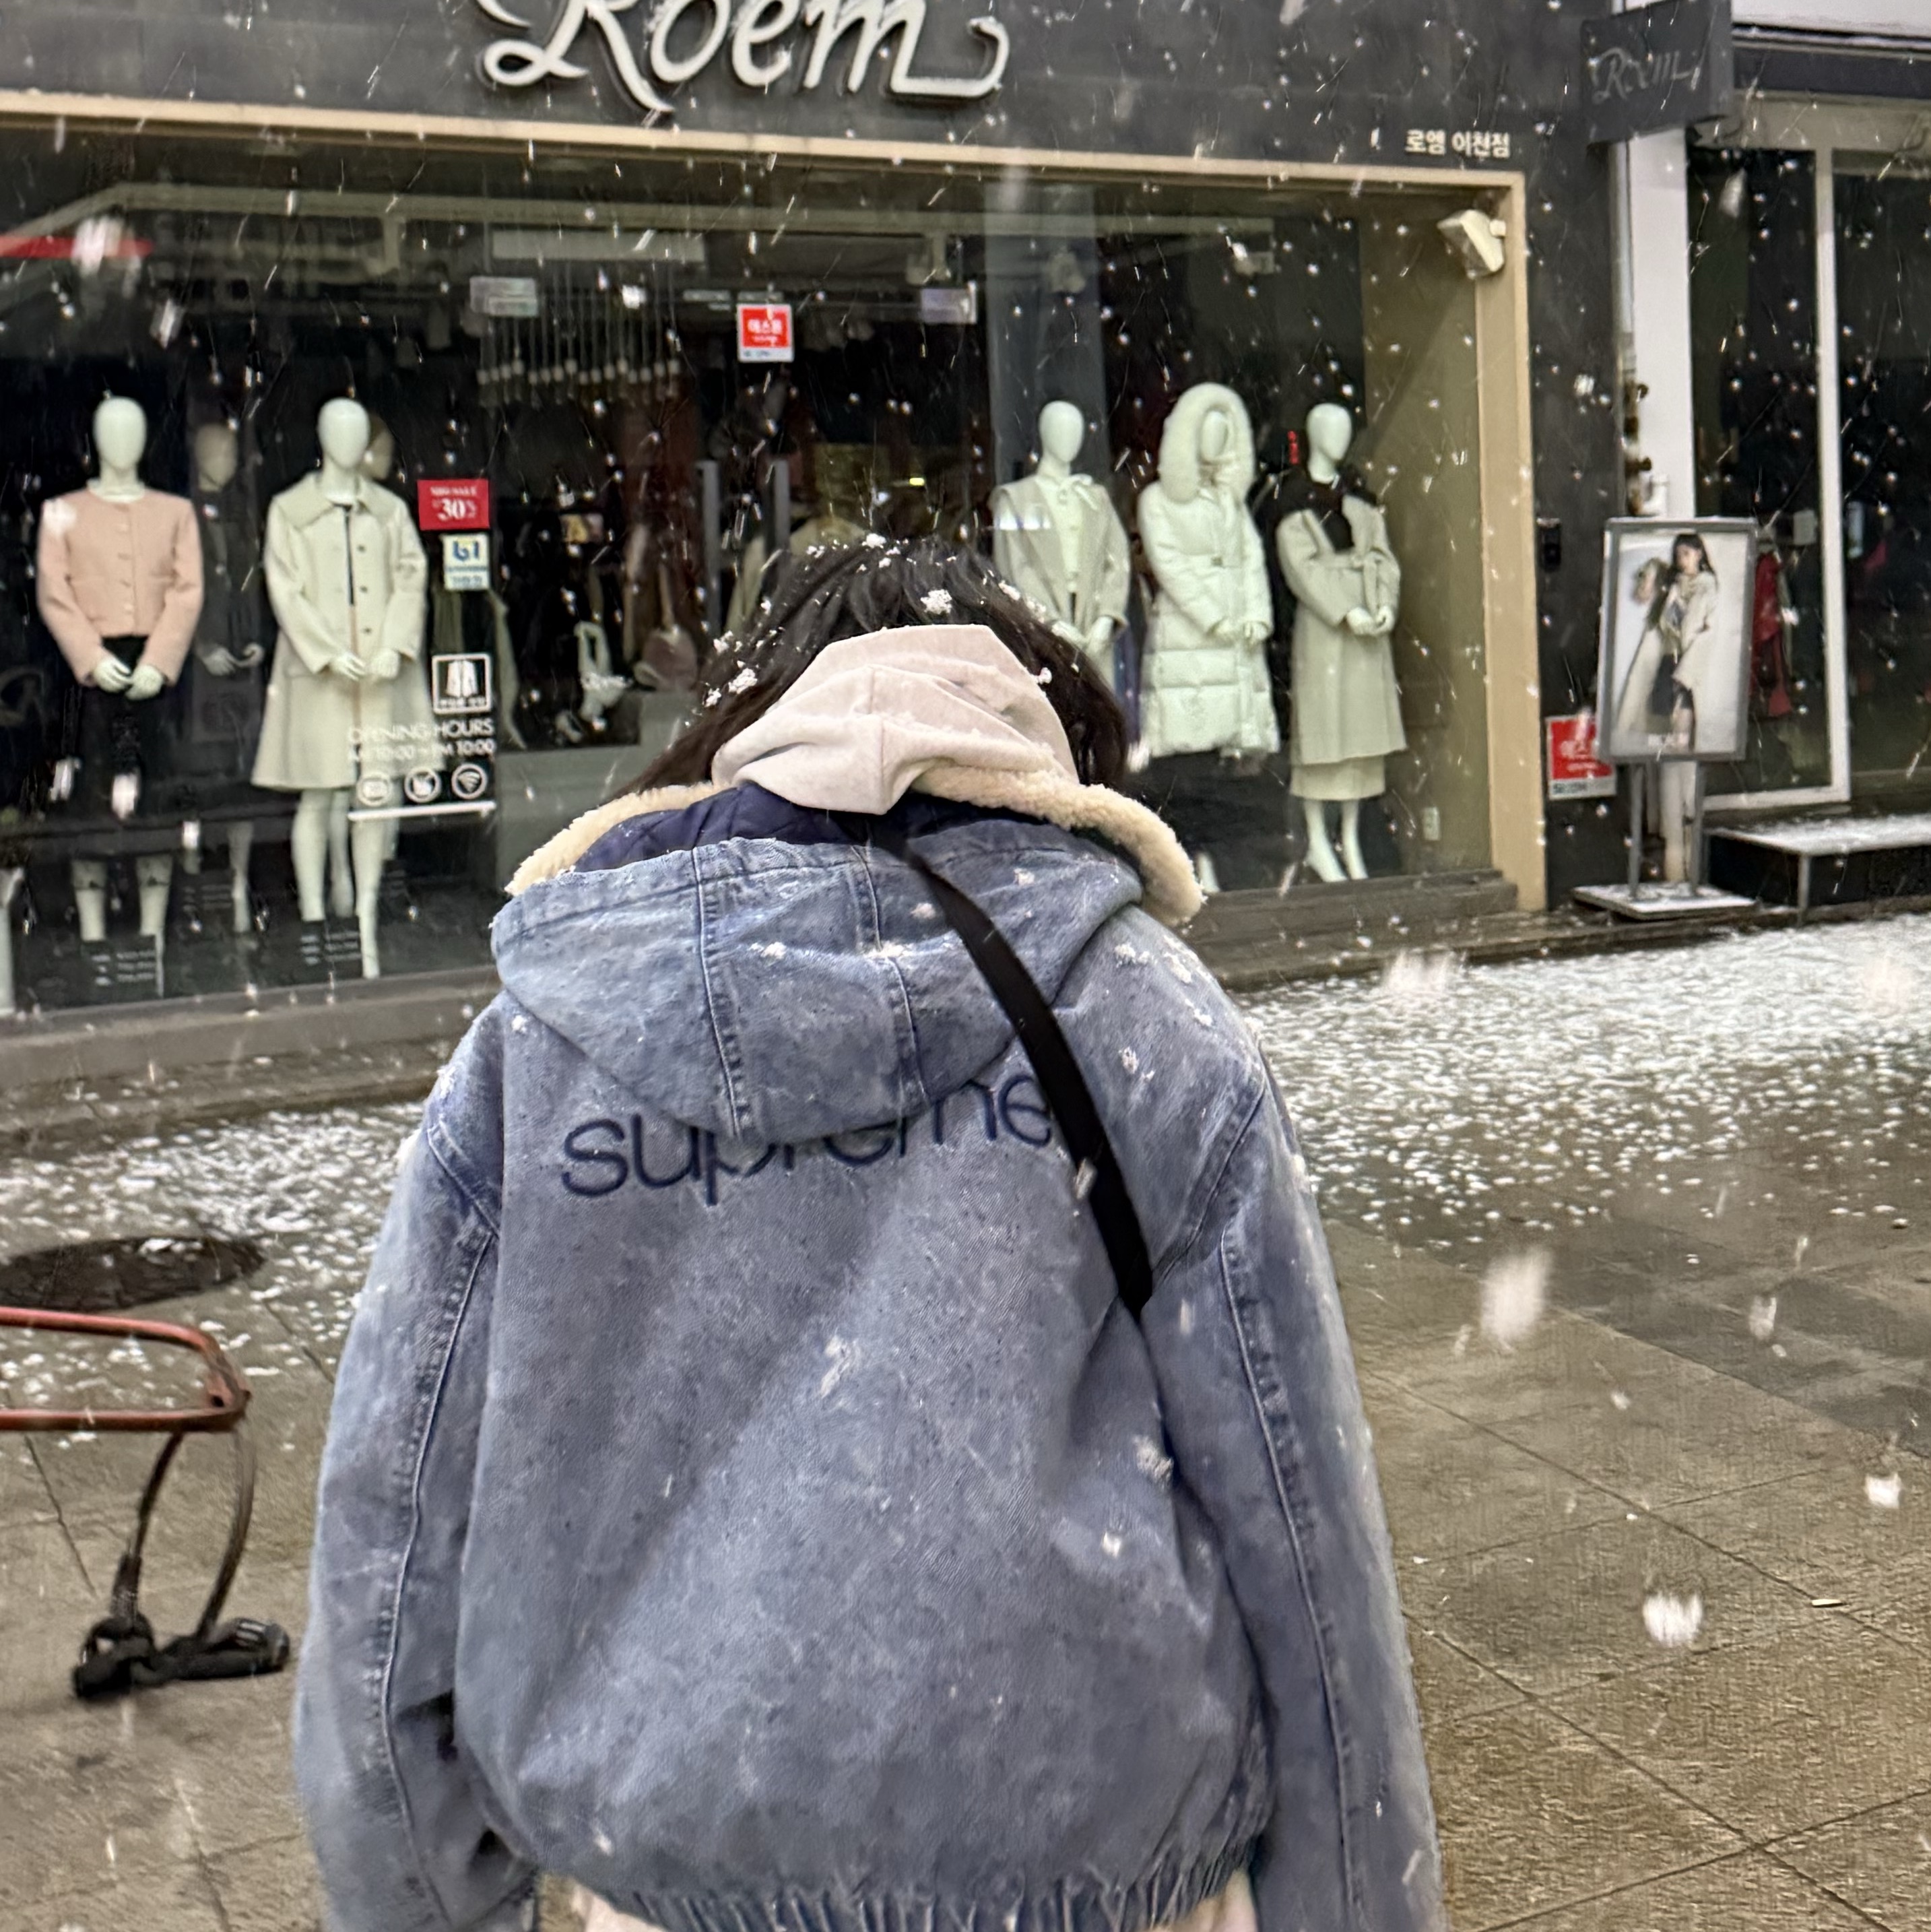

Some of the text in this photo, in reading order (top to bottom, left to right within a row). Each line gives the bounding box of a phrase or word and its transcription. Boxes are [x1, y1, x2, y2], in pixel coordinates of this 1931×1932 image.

[1404, 129, 1511, 158] 로엠 이천점
[435, 717, 494, 738] HOURS
[562, 1075, 1052, 1206] supme
